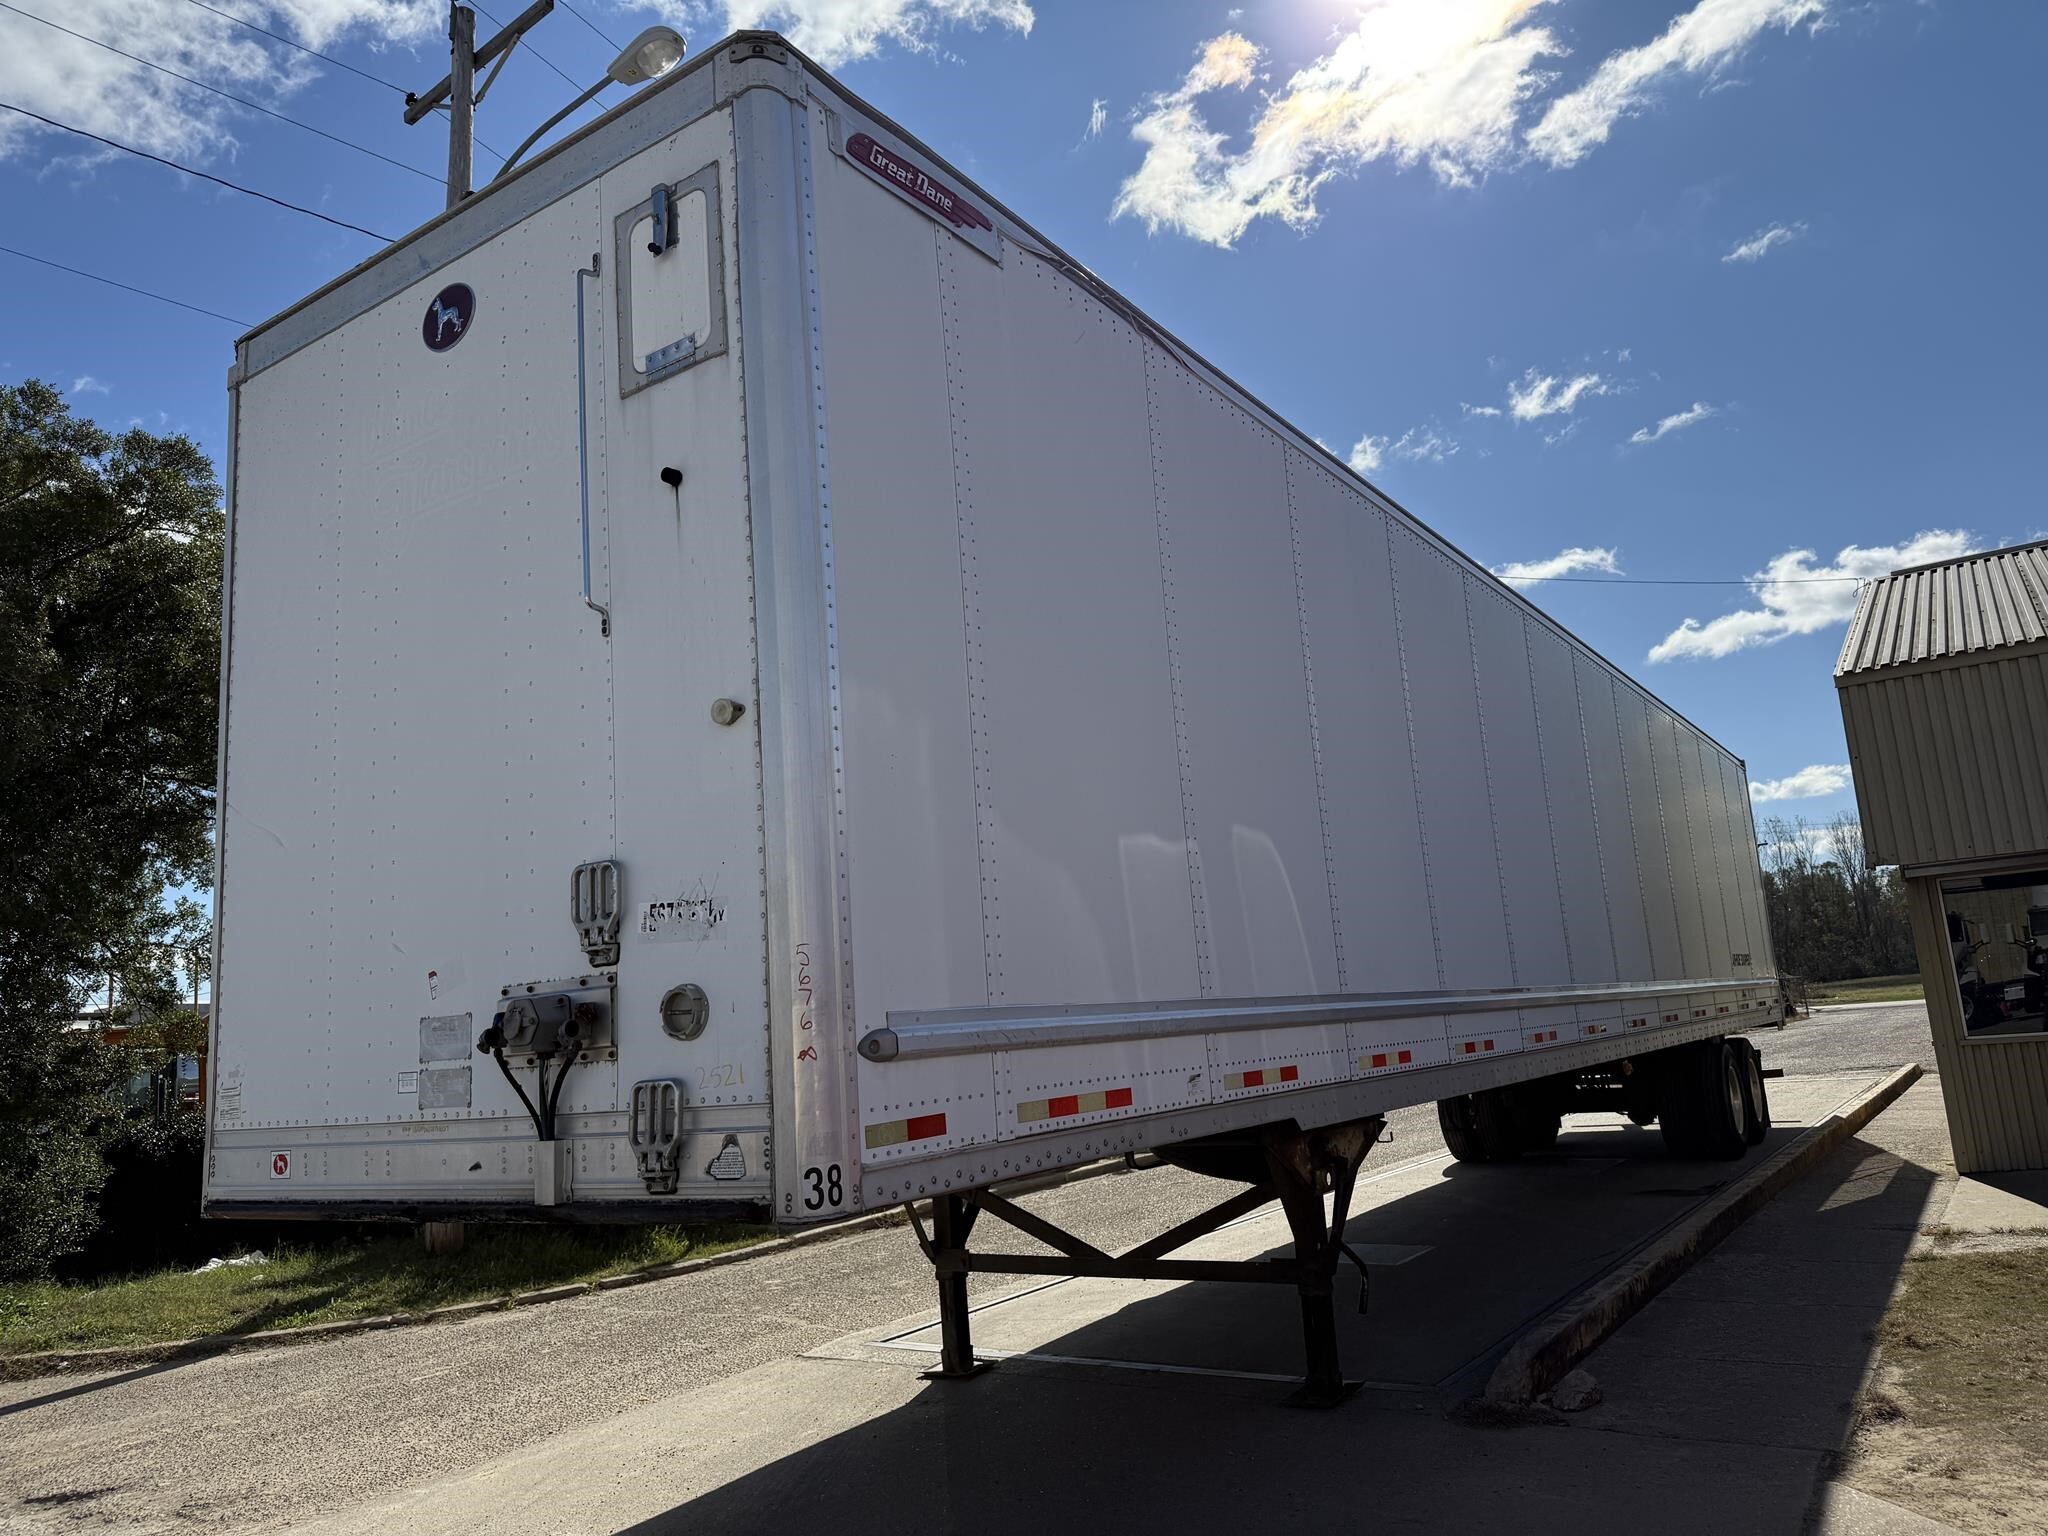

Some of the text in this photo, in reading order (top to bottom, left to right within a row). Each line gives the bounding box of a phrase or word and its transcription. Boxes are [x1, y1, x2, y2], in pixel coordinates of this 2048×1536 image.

[870, 145, 953, 213] Great Dane
[696, 1063, 745, 1090] 2521
[804, 1164, 842, 1211] 38
